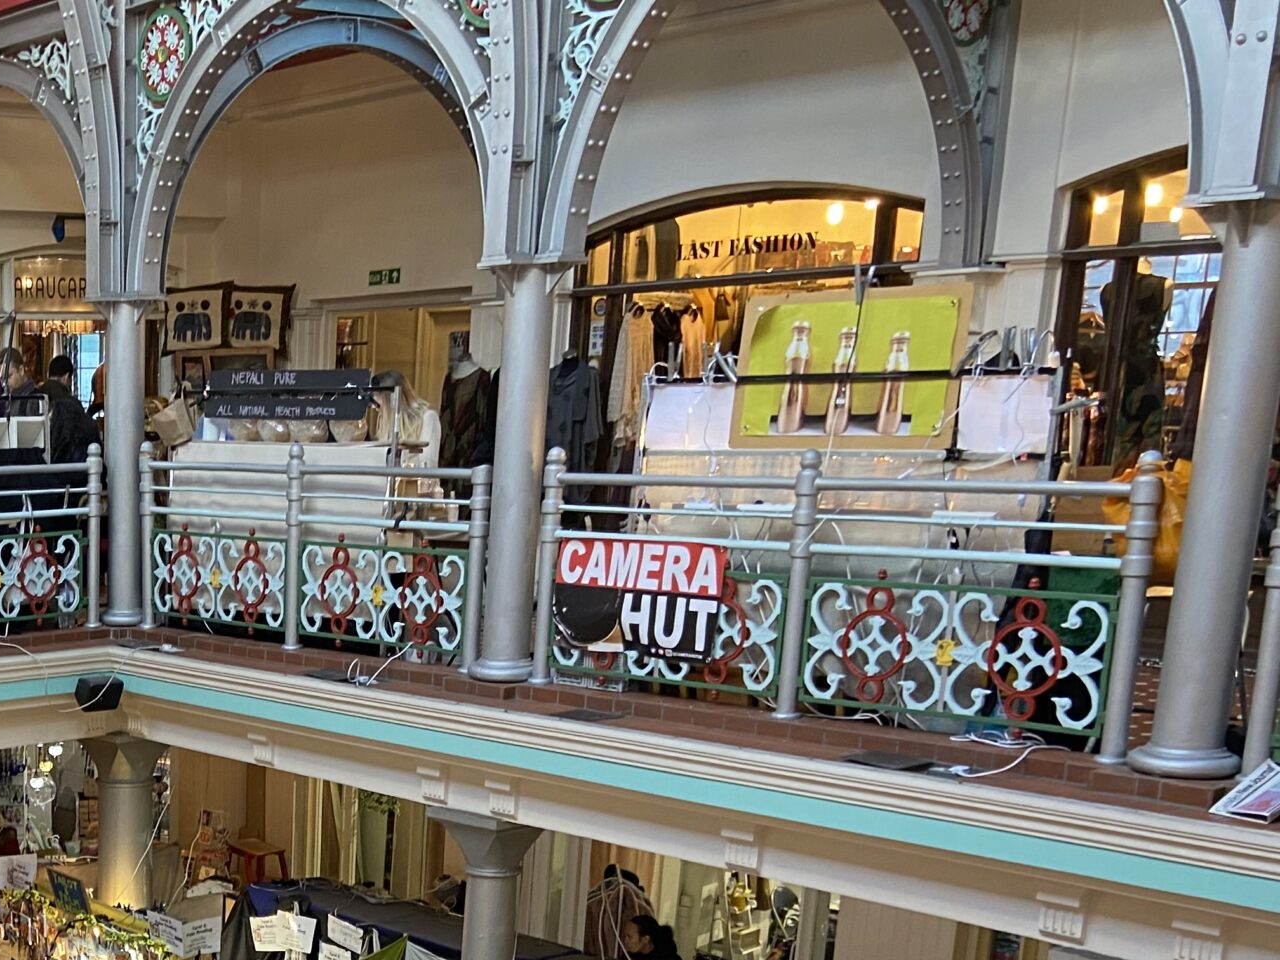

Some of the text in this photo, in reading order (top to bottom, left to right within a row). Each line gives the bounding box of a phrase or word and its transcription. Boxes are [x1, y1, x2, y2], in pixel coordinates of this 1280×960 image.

[729, 231, 819, 257] FASHION
[14, 276, 87, 299] ARAUCAR
[231, 371, 297, 386] NEPALI PURE
[216, 405, 233, 417] ALL
[238, 405, 269, 417] NATURAL
[275, 406, 301, 417] HEALTH
[560, 539, 719, 596] CAMERA
[620, 592, 719, 652] HUT
